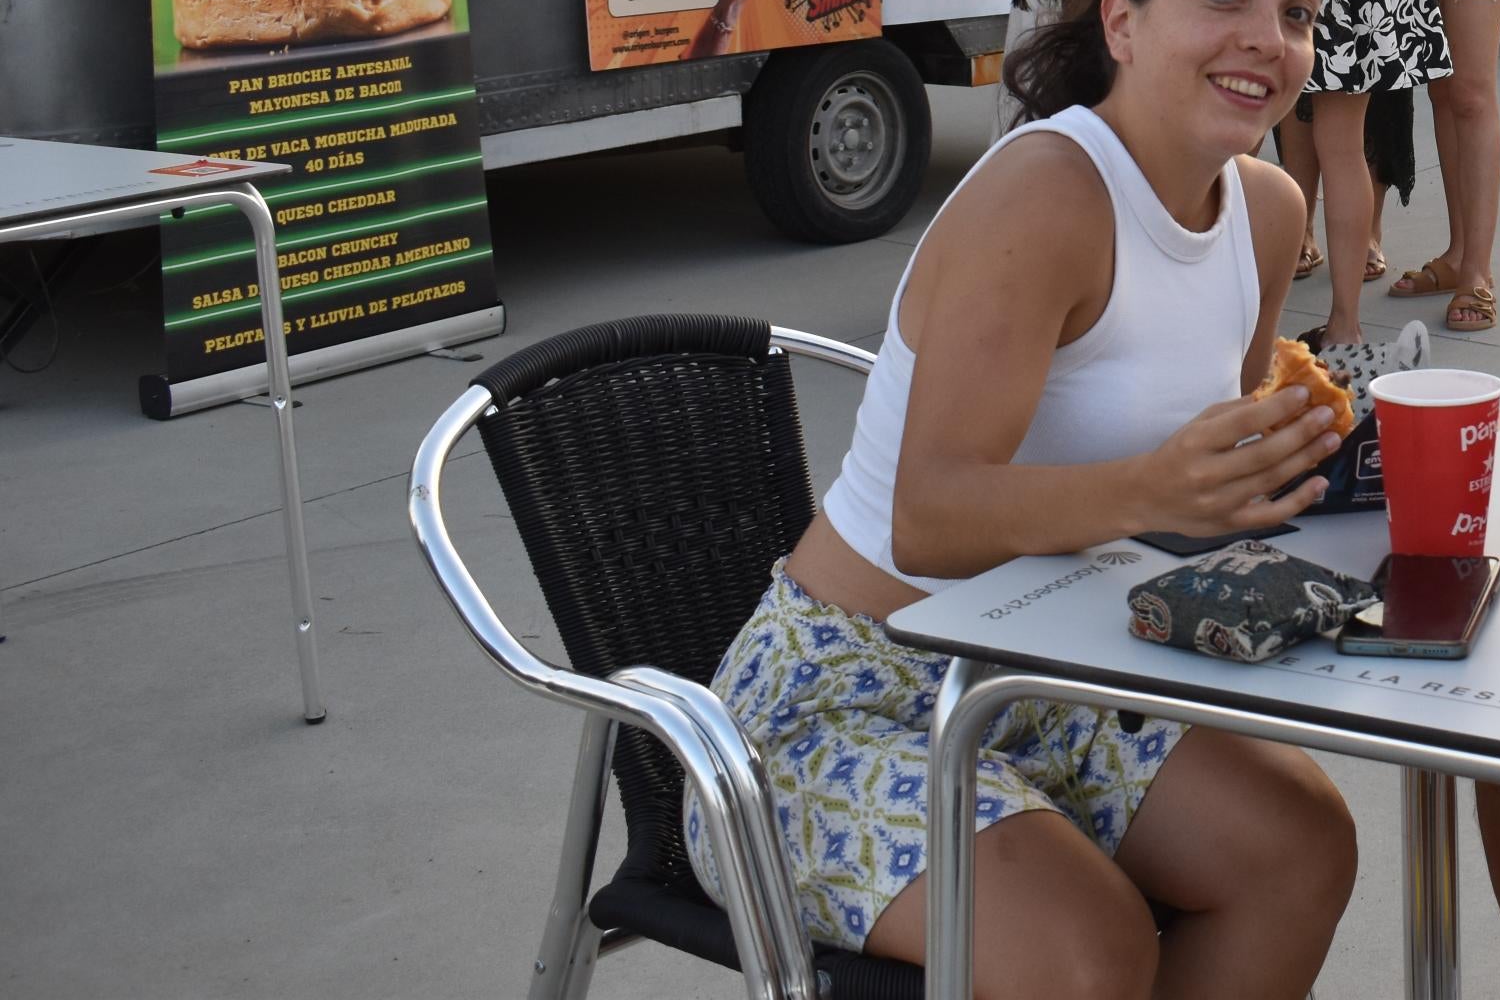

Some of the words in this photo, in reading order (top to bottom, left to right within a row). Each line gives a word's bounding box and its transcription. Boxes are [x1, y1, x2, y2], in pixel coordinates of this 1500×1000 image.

[229, 78, 263, 94] PAN
[268, 68, 331, 88] BRIOCHE
[336, 56, 412, 79] ARTESANAL
[249, 90, 331, 114] MAYONESA
[335, 87, 355, 101] DE
[246, 145, 267, 161] DE
[271, 138, 311, 156] VACA
[314, 126, 386, 149] MORUCHA
[390, 113, 457, 137] MADURADA
[305, 158, 324, 172] 40
[329, 150, 365, 169] DÍAS
[277, 201, 324, 225] QUESO
[328, 190, 396, 213] CHEDDAR
[277, 246, 327, 268] BACON
[332, 232, 399, 257] CRUNCHY
[192, 287, 243, 309] SALSA
[247, 284, 261, 297] D
[280, 271, 319, 290] UESO
[323, 255, 392, 280] CHEDDAR
[395, 237, 471, 265] AMERICANO
[204, 321, 292, 353] PELOTAS
[296, 318, 306, 331] Y
[311, 305, 365, 328] LLUVIA
[369, 299, 388, 314] DE
[392, 280, 466, 309] PELOTAZOS
[1023, 564, 1110, 601] Xacobeo
[1315, 664, 1336, 673] A
[1358, 670, 1401, 684] LA
